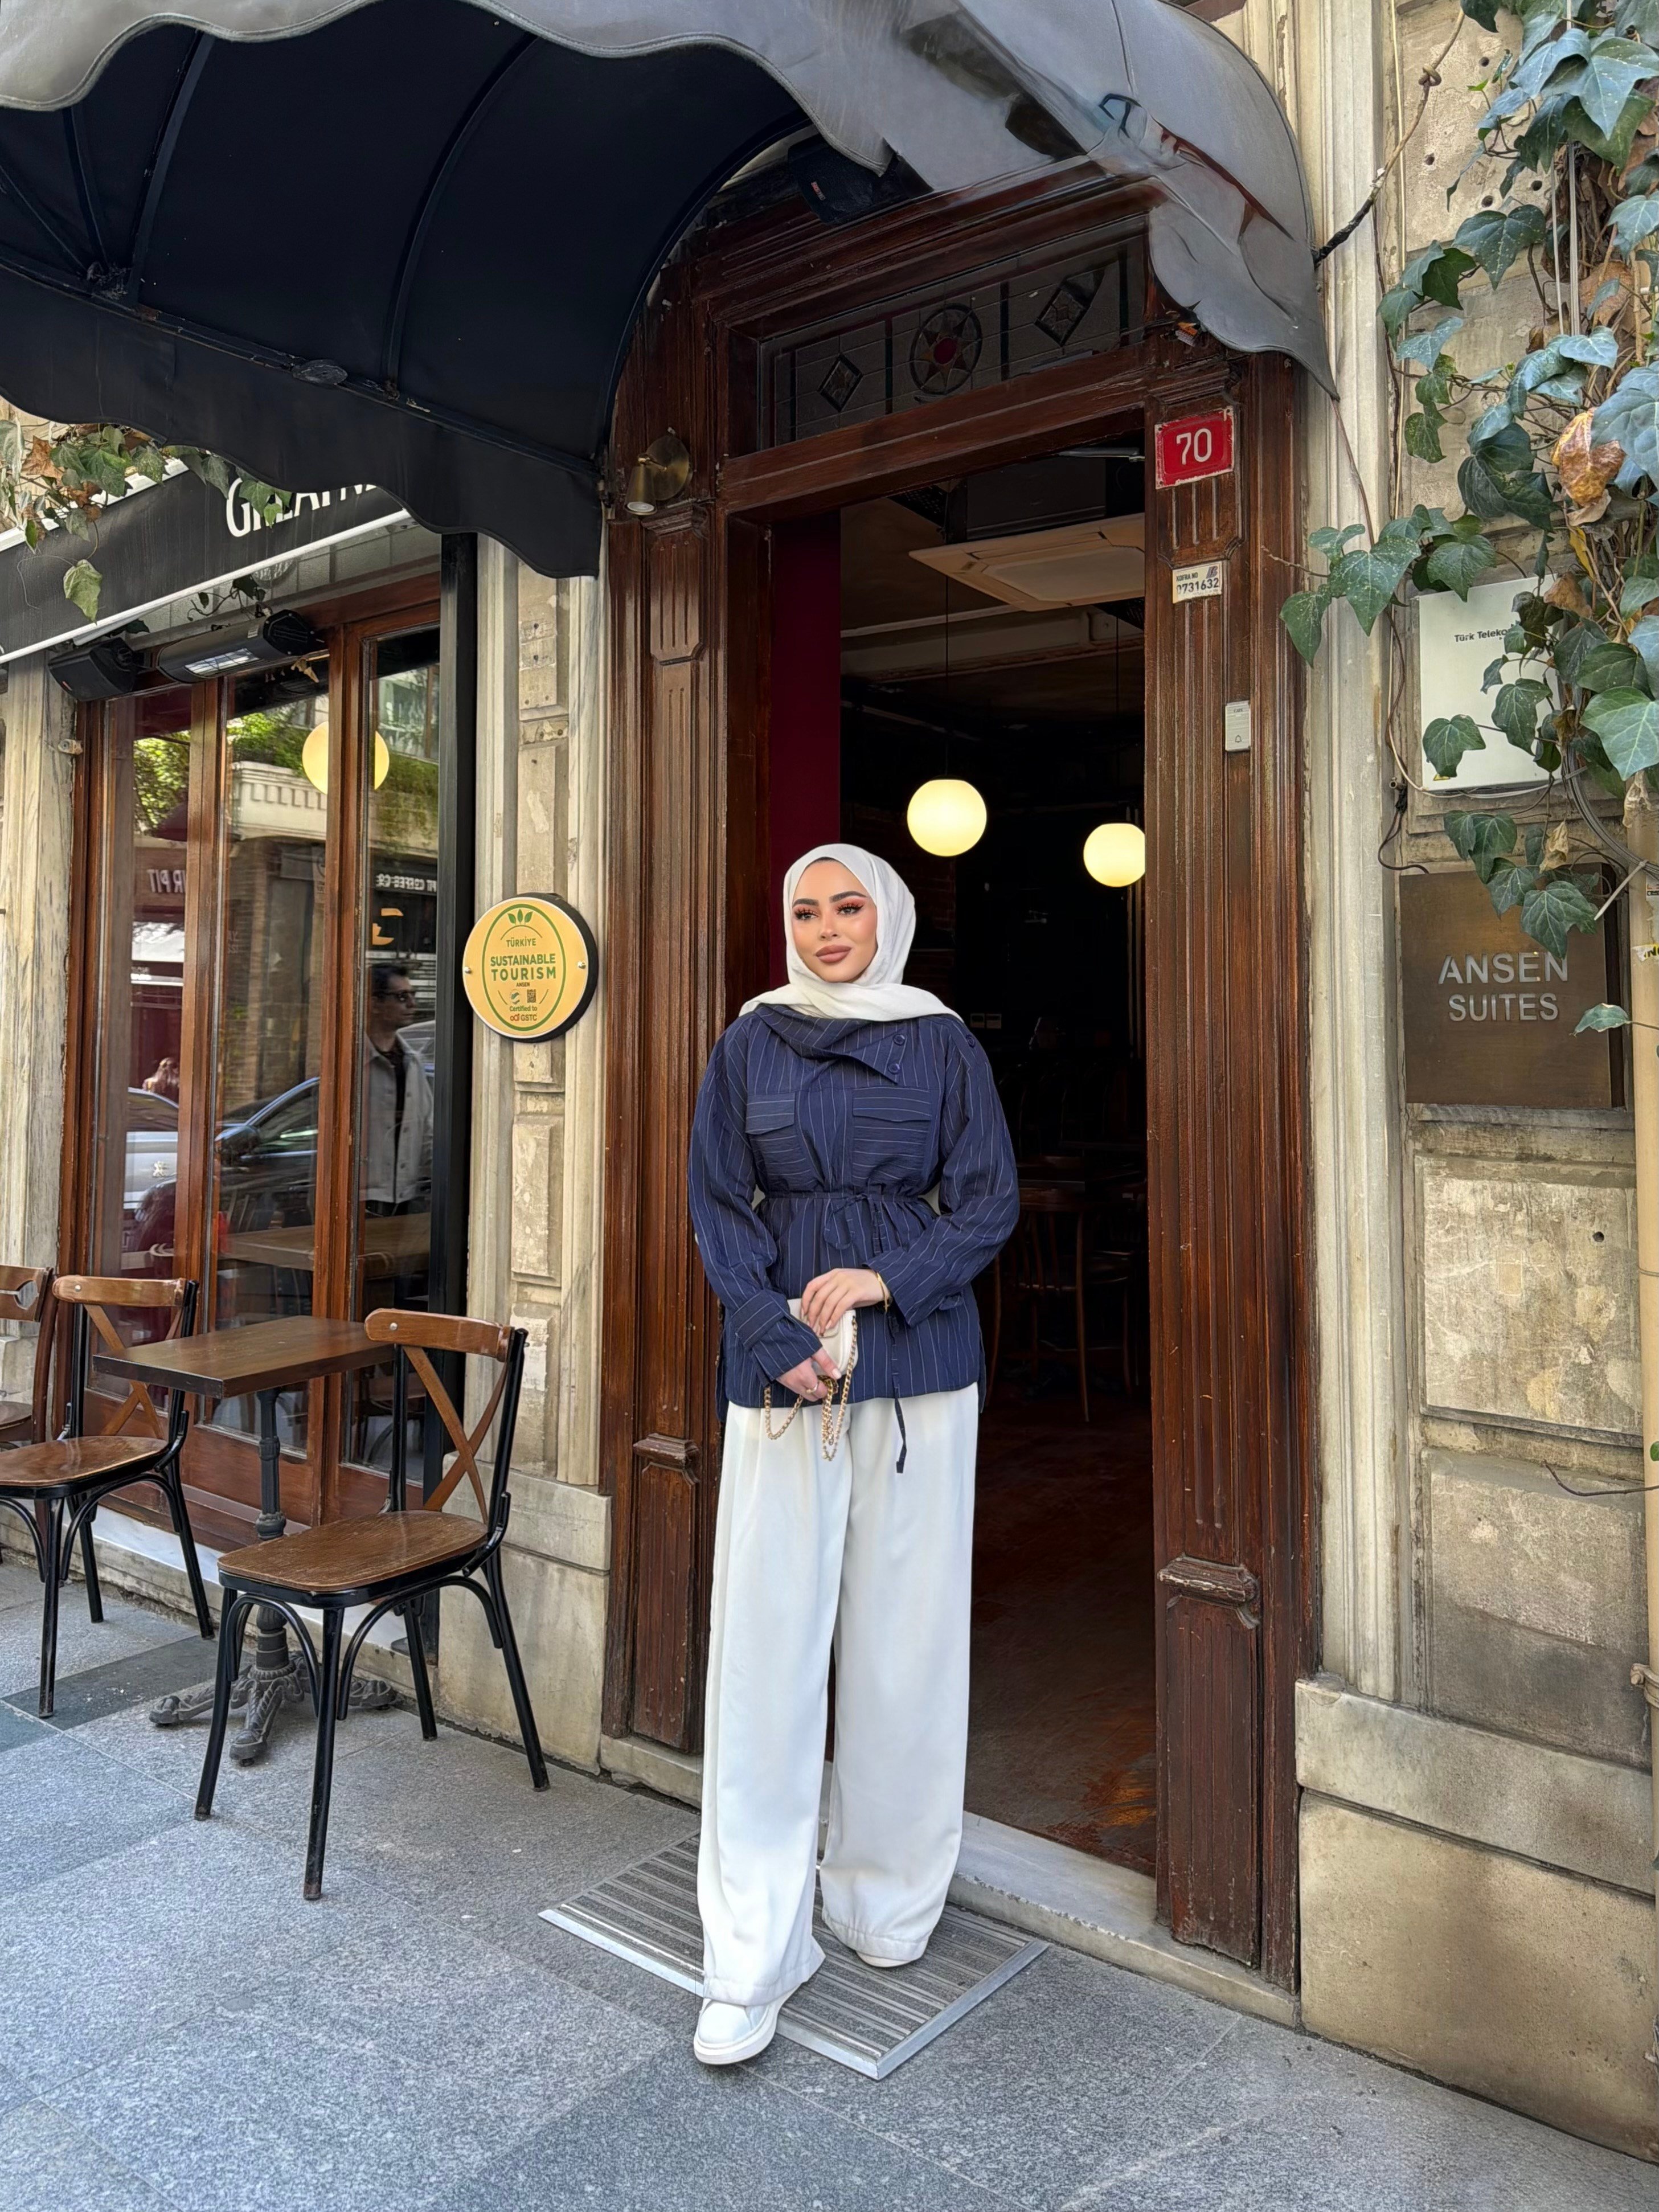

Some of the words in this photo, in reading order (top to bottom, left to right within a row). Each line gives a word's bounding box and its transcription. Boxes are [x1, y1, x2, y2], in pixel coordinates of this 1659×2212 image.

[1176, 428, 1212, 465] 70
[1454, 633, 1474, 642] Türk
[1477, 628, 1509, 639] Teleko
[506, 936, 536, 948] TÜRKİYE
[490, 953, 556, 966] SUSTAINABLE
[491, 966, 556, 981] TOURISM
[1438, 952, 1568, 984] ANSEN
[1448, 993, 1559, 1022] SUITES
